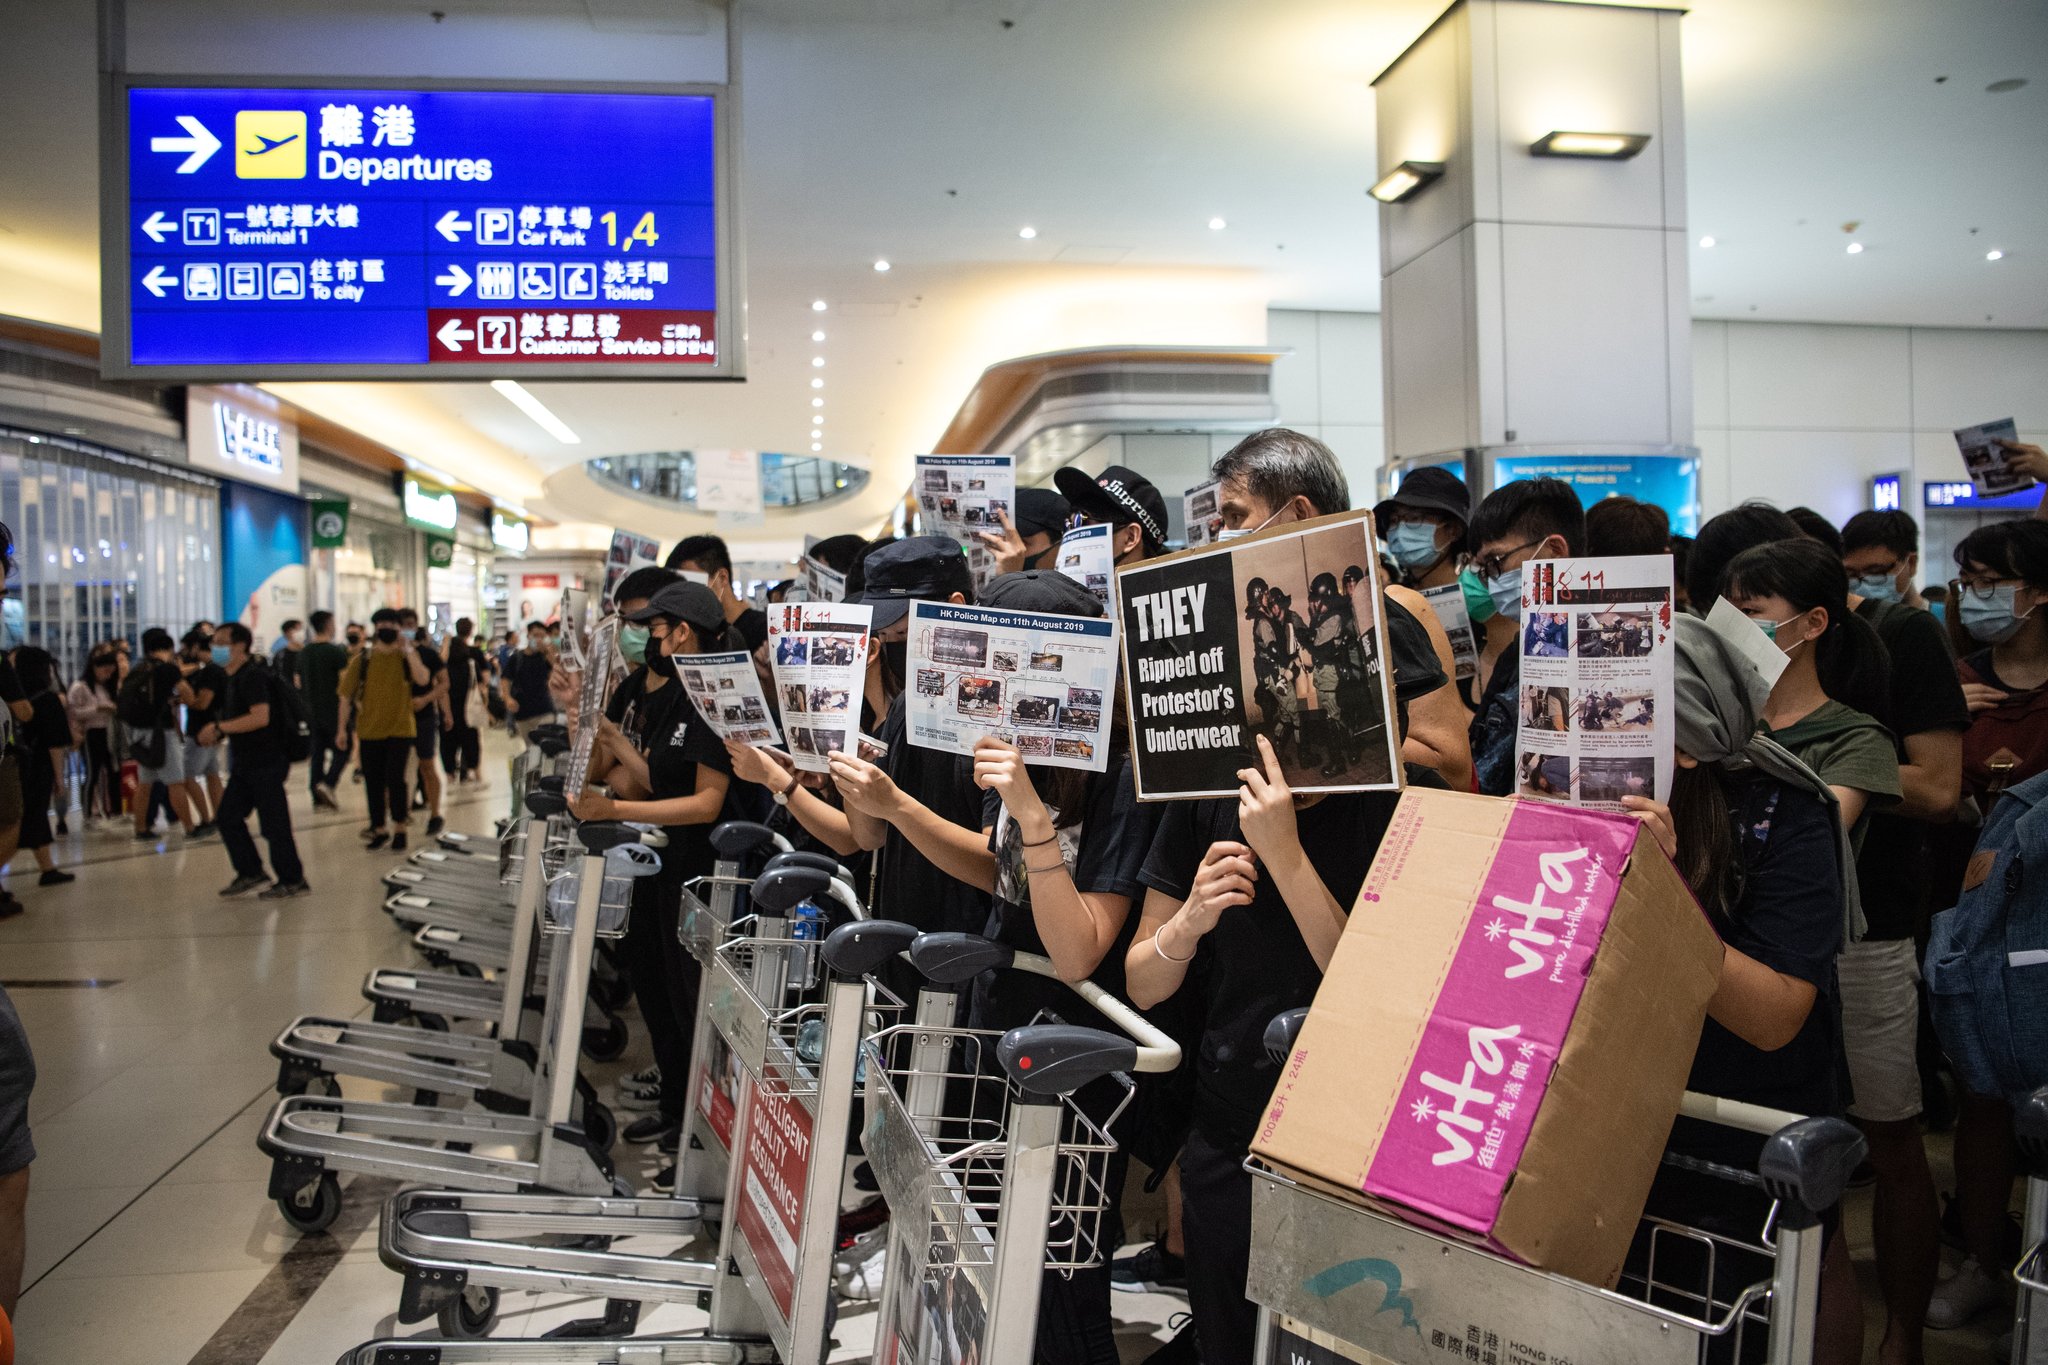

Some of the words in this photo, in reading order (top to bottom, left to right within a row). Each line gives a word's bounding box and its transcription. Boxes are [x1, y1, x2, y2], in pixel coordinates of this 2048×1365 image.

[319, 103, 416, 147] 離港
[319, 150, 492, 186] Departures
[224, 204, 360, 228] 一號客運大樓
[518, 205, 593, 230] 停車場
[225, 228, 296, 244] Terminal
[299, 228, 308, 245] 1
[517, 229, 547, 246] Car
[550, 229, 586, 246] Park
[600, 211, 659, 252] 1,4
[310, 258, 385, 282] 往市區
[602, 260, 669, 284] 洗手間
[310, 283, 331, 300] To
[334, 283, 364, 303] city
[602, 284, 654, 301] Toilets
[520, 312, 621, 339] 旅客服務
[520, 338, 599, 355] Customer
[601, 338, 661, 355] Service
[1104, 480, 1161, 539] Supreme
[940, 609, 953, 618] HK
[954, 611, 979, 621] Police
[981, 614, 998, 626] Map
[1000, 617, 1010, 625] on
[1012, 616, 1030, 627] 11th
[1032, 619, 1063, 631] August
[1064, 622, 1084, 631] 2019
[1131, 583, 1207, 642] THEY
[1138, 650, 1197, 683] Ripped
[1200, 646, 1224, 675] off
[1142, 684, 1235, 718] Protestor's
[1145, 724, 1240, 753] Underwear
[1549, 951, 1567, 983] pure
[1559, 896, 1589, 949] distilled
[1584, 853, 1603, 893] water
[757, 1082, 809, 1162] INTELLIGENT
[754, 1106, 788, 1168] QUALITY
[750, 1133, 798, 1225] ASSURANCE
[1432, 1329, 1497, 1365] 國際機場
[1467, 1324, 1499, 1351] 香港
[1510, 1340, 1546, 1361] HONG
